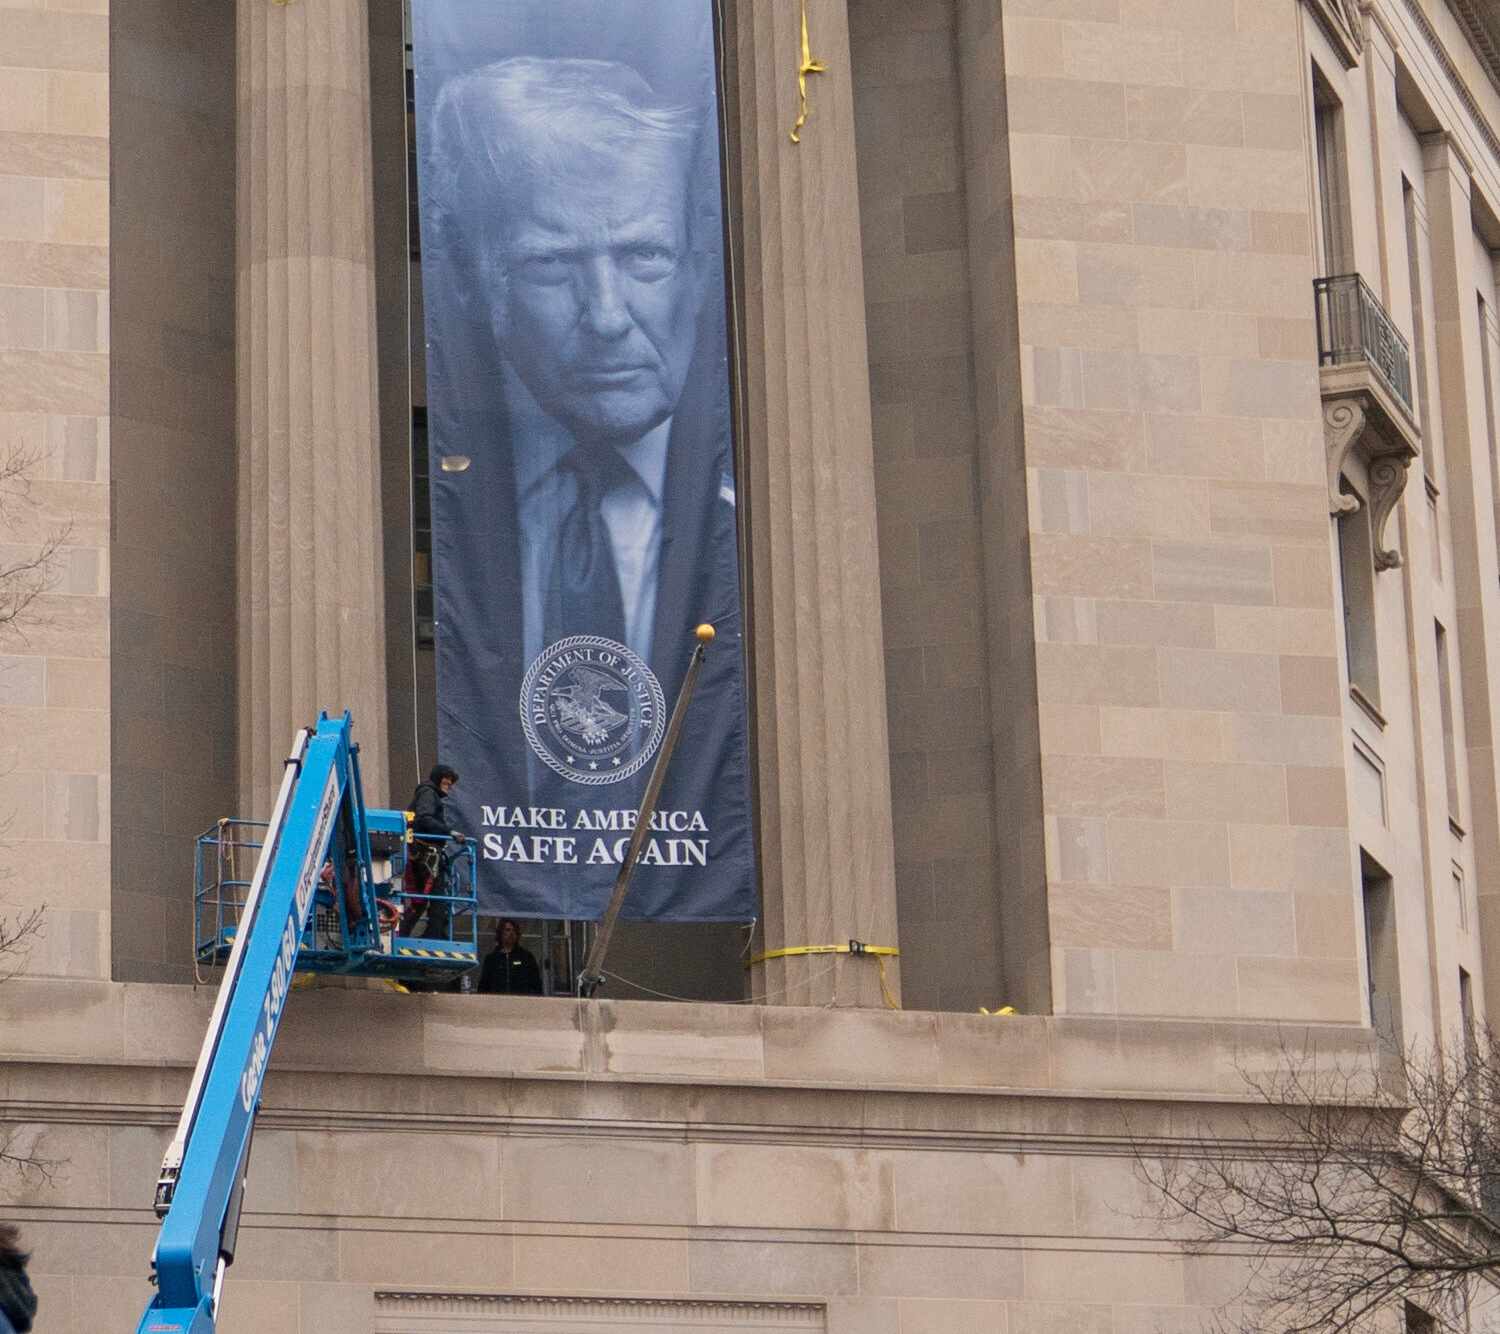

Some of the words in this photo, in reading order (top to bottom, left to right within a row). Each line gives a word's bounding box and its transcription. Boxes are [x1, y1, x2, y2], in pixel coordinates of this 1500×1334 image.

[532, 649, 594, 726] DEPARTMENT
[599, 652, 621, 667] OF
[621, 666, 654, 729] JUSTICE
[480, 805, 567, 829] MAKE
[482, 833, 578, 864] SAFE
